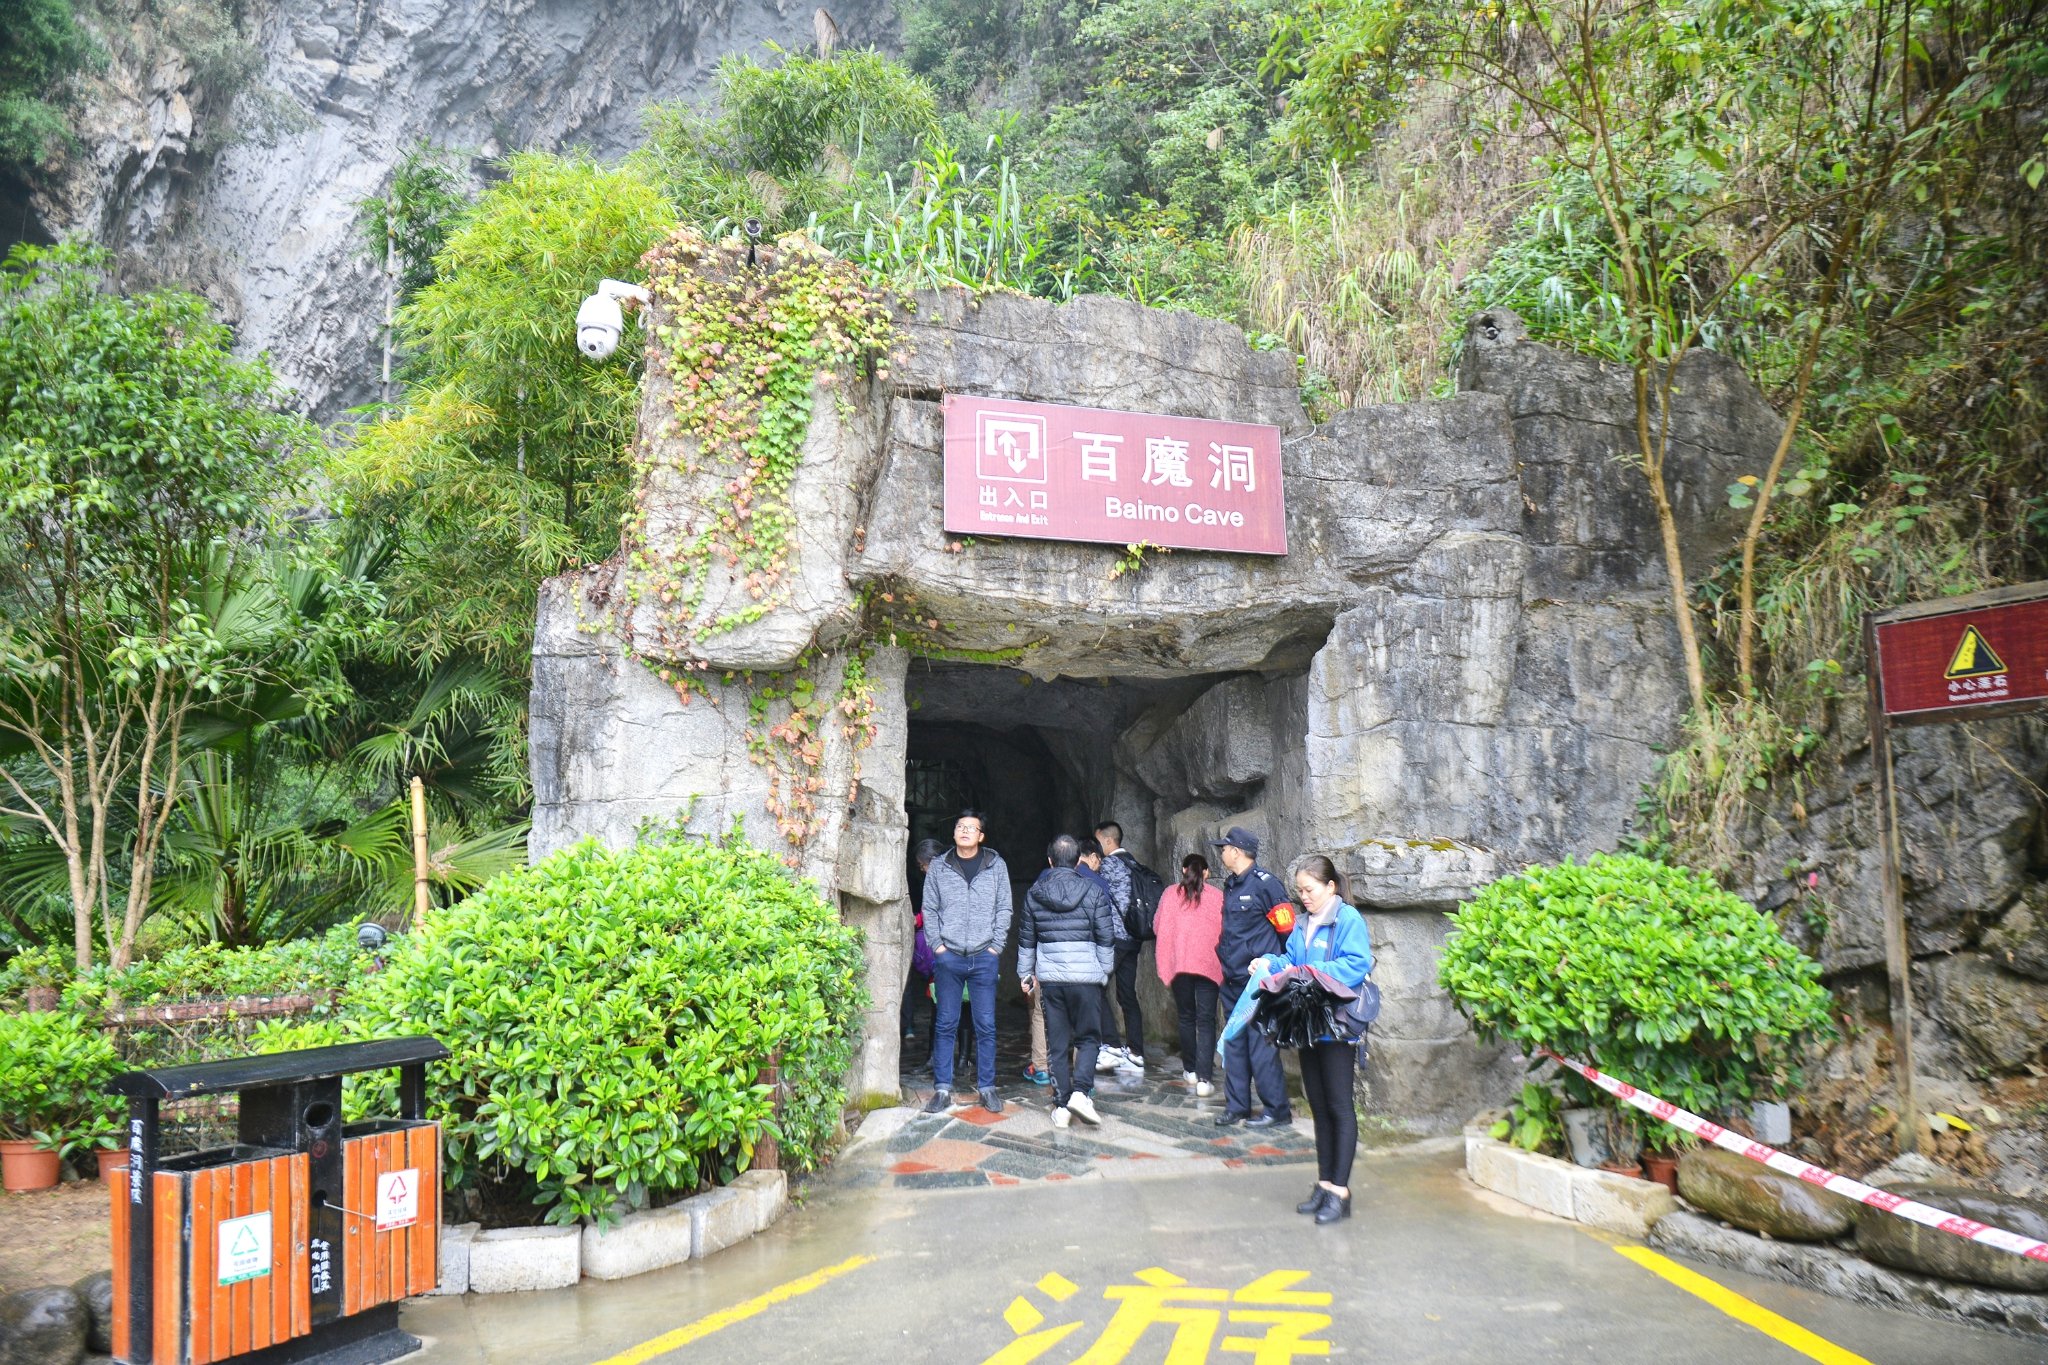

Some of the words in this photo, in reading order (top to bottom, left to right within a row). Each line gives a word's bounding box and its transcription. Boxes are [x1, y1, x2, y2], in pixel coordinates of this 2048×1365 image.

[1072, 431, 1256, 492] 百魔洞
[979, 484, 1048, 509] 出入口
[1105, 496, 1179, 522] Baimo
[1184, 503, 1244, 528] Cave
